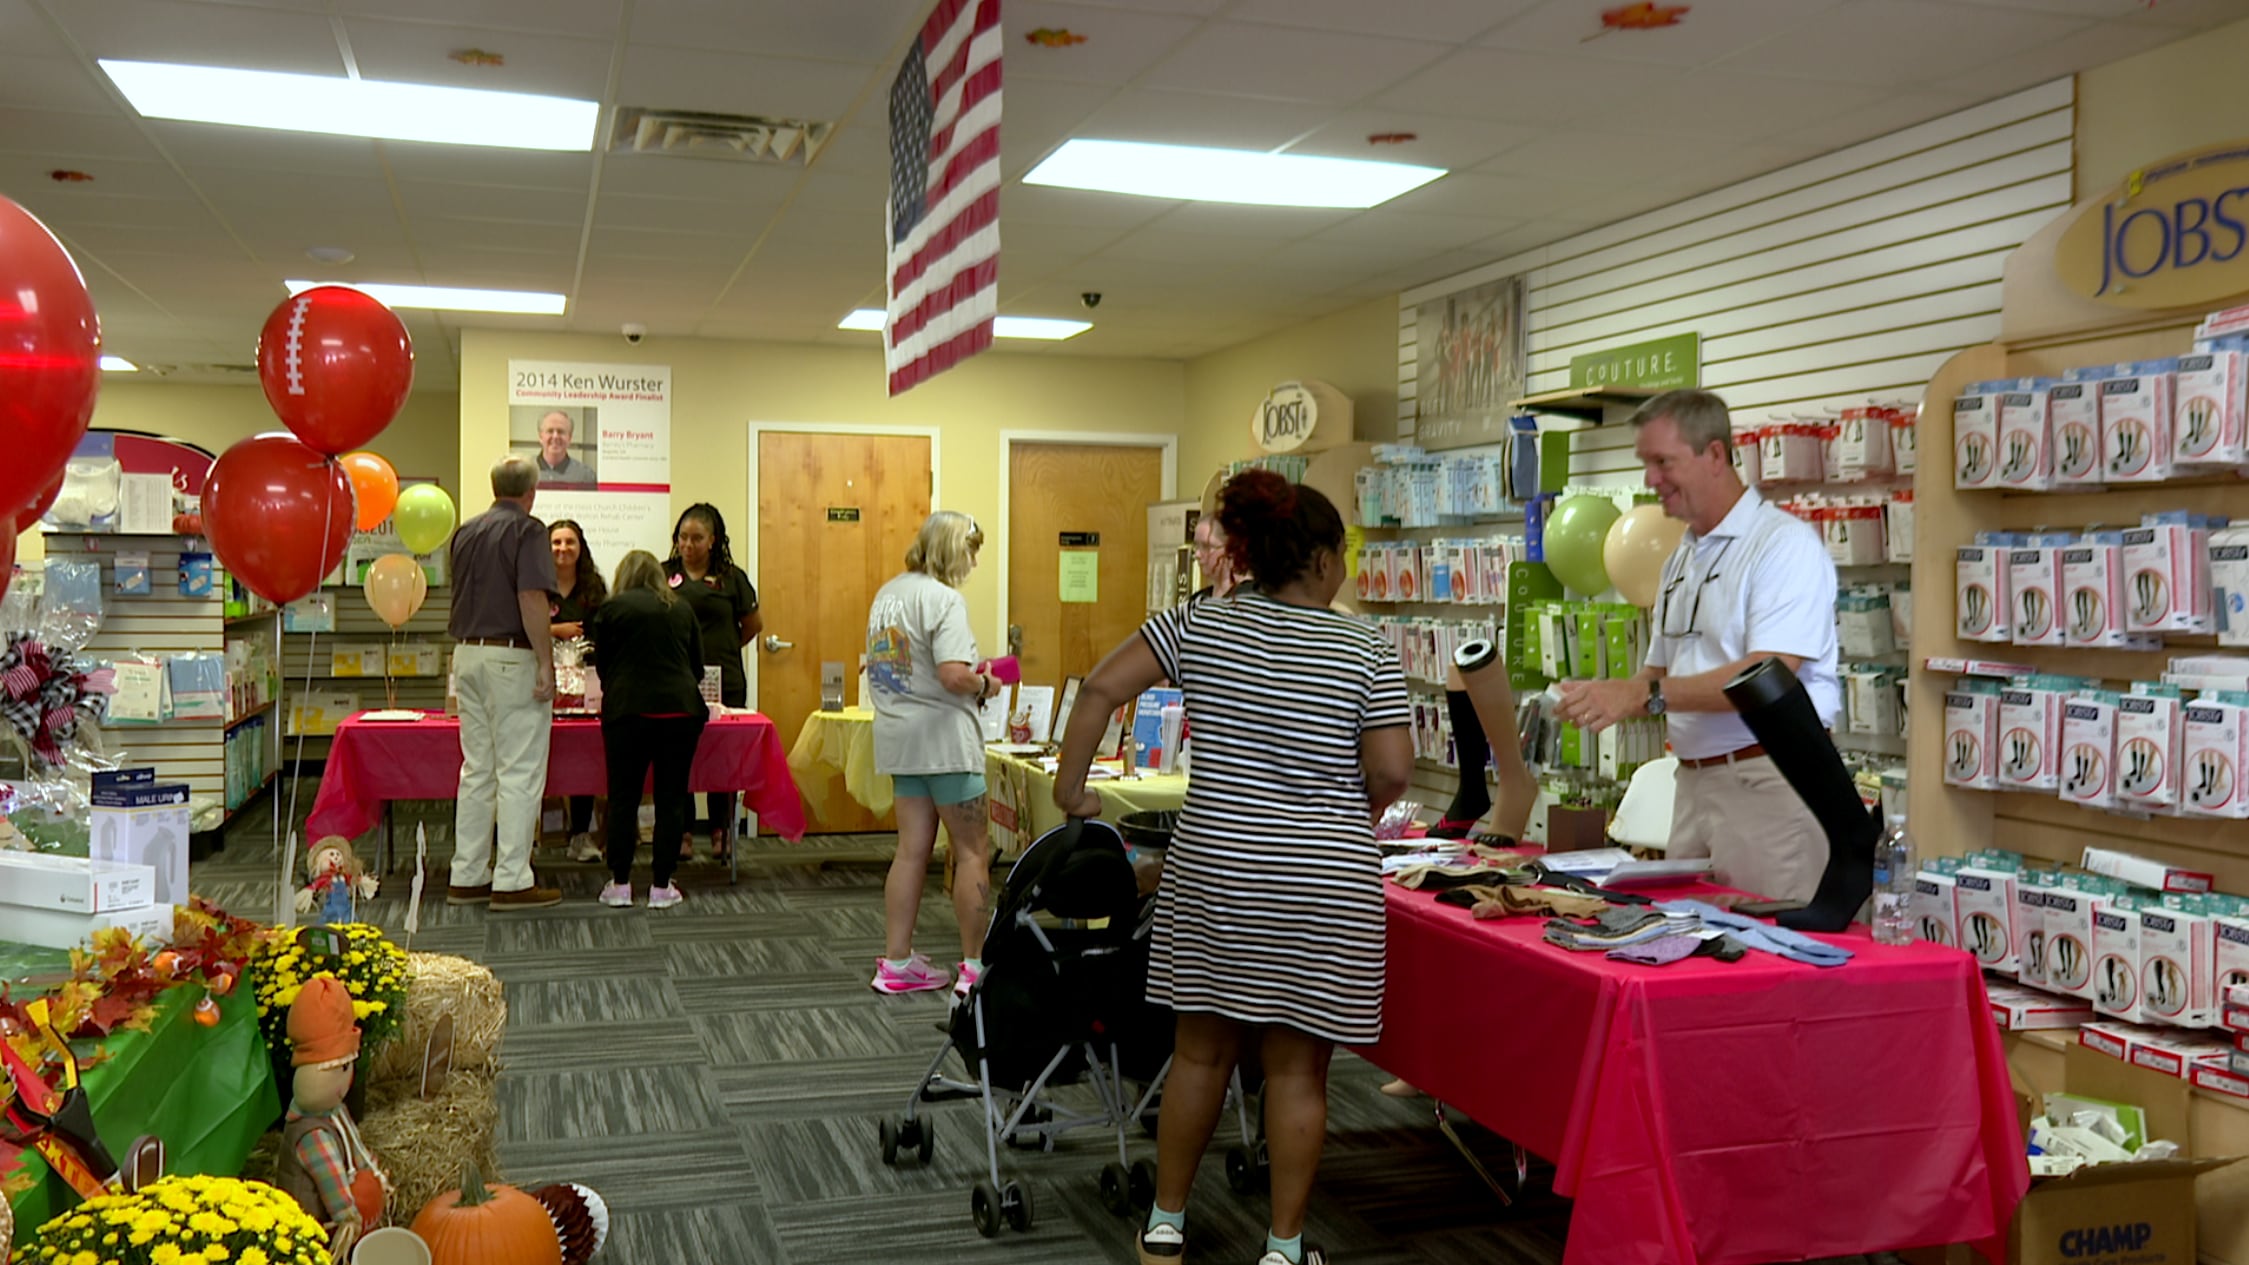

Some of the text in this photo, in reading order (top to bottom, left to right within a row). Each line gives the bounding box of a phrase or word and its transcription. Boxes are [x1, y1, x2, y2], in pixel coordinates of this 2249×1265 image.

[2094, 186, 2249, 298] JOBS
[516, 372, 663, 392] 2014 Ken Wurster
[602, 430, 654, 440] Barry Bryant
[1262, 400, 1303, 445] JOBST
[2059, 1223, 2151, 1257] CHAMP
